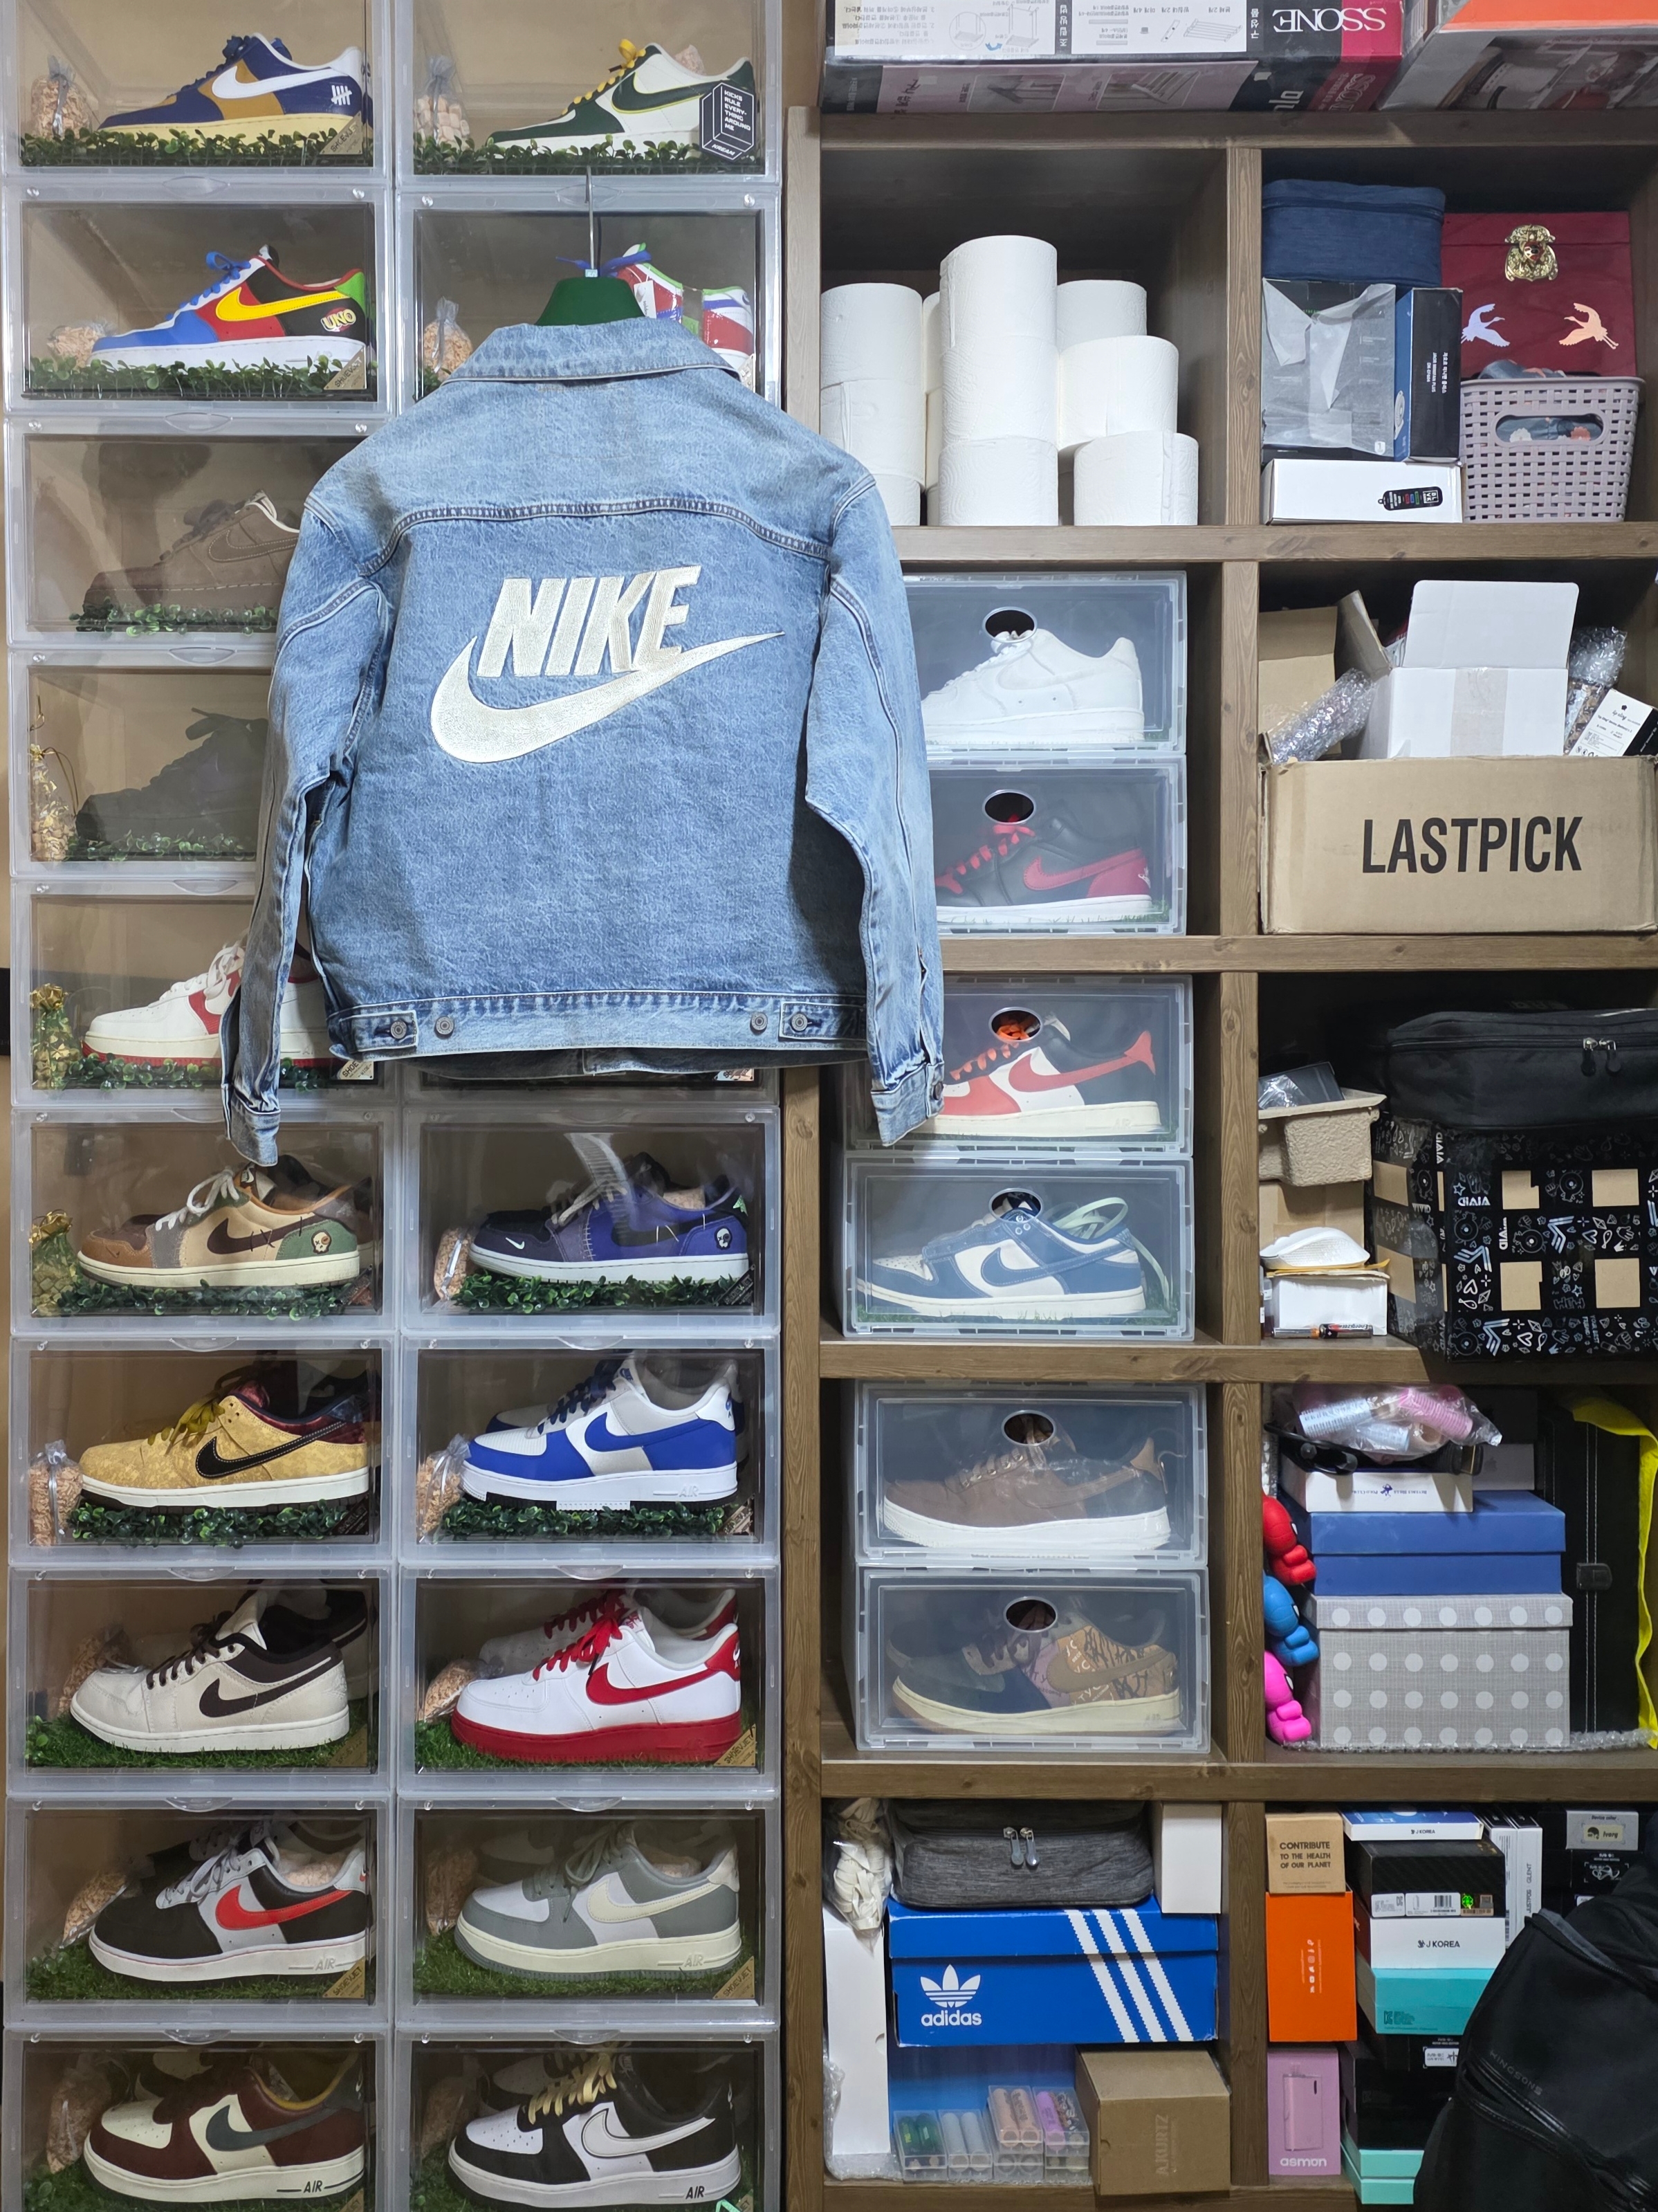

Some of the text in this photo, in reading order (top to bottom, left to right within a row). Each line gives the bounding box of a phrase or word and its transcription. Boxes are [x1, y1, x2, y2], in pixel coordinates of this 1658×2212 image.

[1059, 4, 1067, 46] 조립방법
[1251, 8, 1259, 39] 구성품
[1272, 8, 1387, 33] SSONE
[724, 90, 742, 102] KICKS
[724, 97, 741, 107] RULE
[724, 110, 744, 122] THING
[724, 117, 750, 131] AROUND
[712, 144, 735, 156] KREAM
[321, 309, 356, 331] UNO
[477, 565, 701, 677] NIKE
[1362, 816, 1583, 875] LASTPICK
[342, 1060, 359, 1077] SHOE
[1458, 1196, 1491, 1206] VIVID
[1412, 1203, 1431, 1214] VIVID
[679, 1486, 699, 1497] AIR
[1280, 1841, 1330, 1850] CONTRIBUTE
[315, 1957, 336, 1971] AIR
[685, 1954, 703, 1967] AIR
[723, 1966, 752, 1997] SHOEVJET
[921, 2009, 982, 2027] adidas
[304, 2180, 323, 2193] AIR
[685, 2185, 705, 2199] AIR
